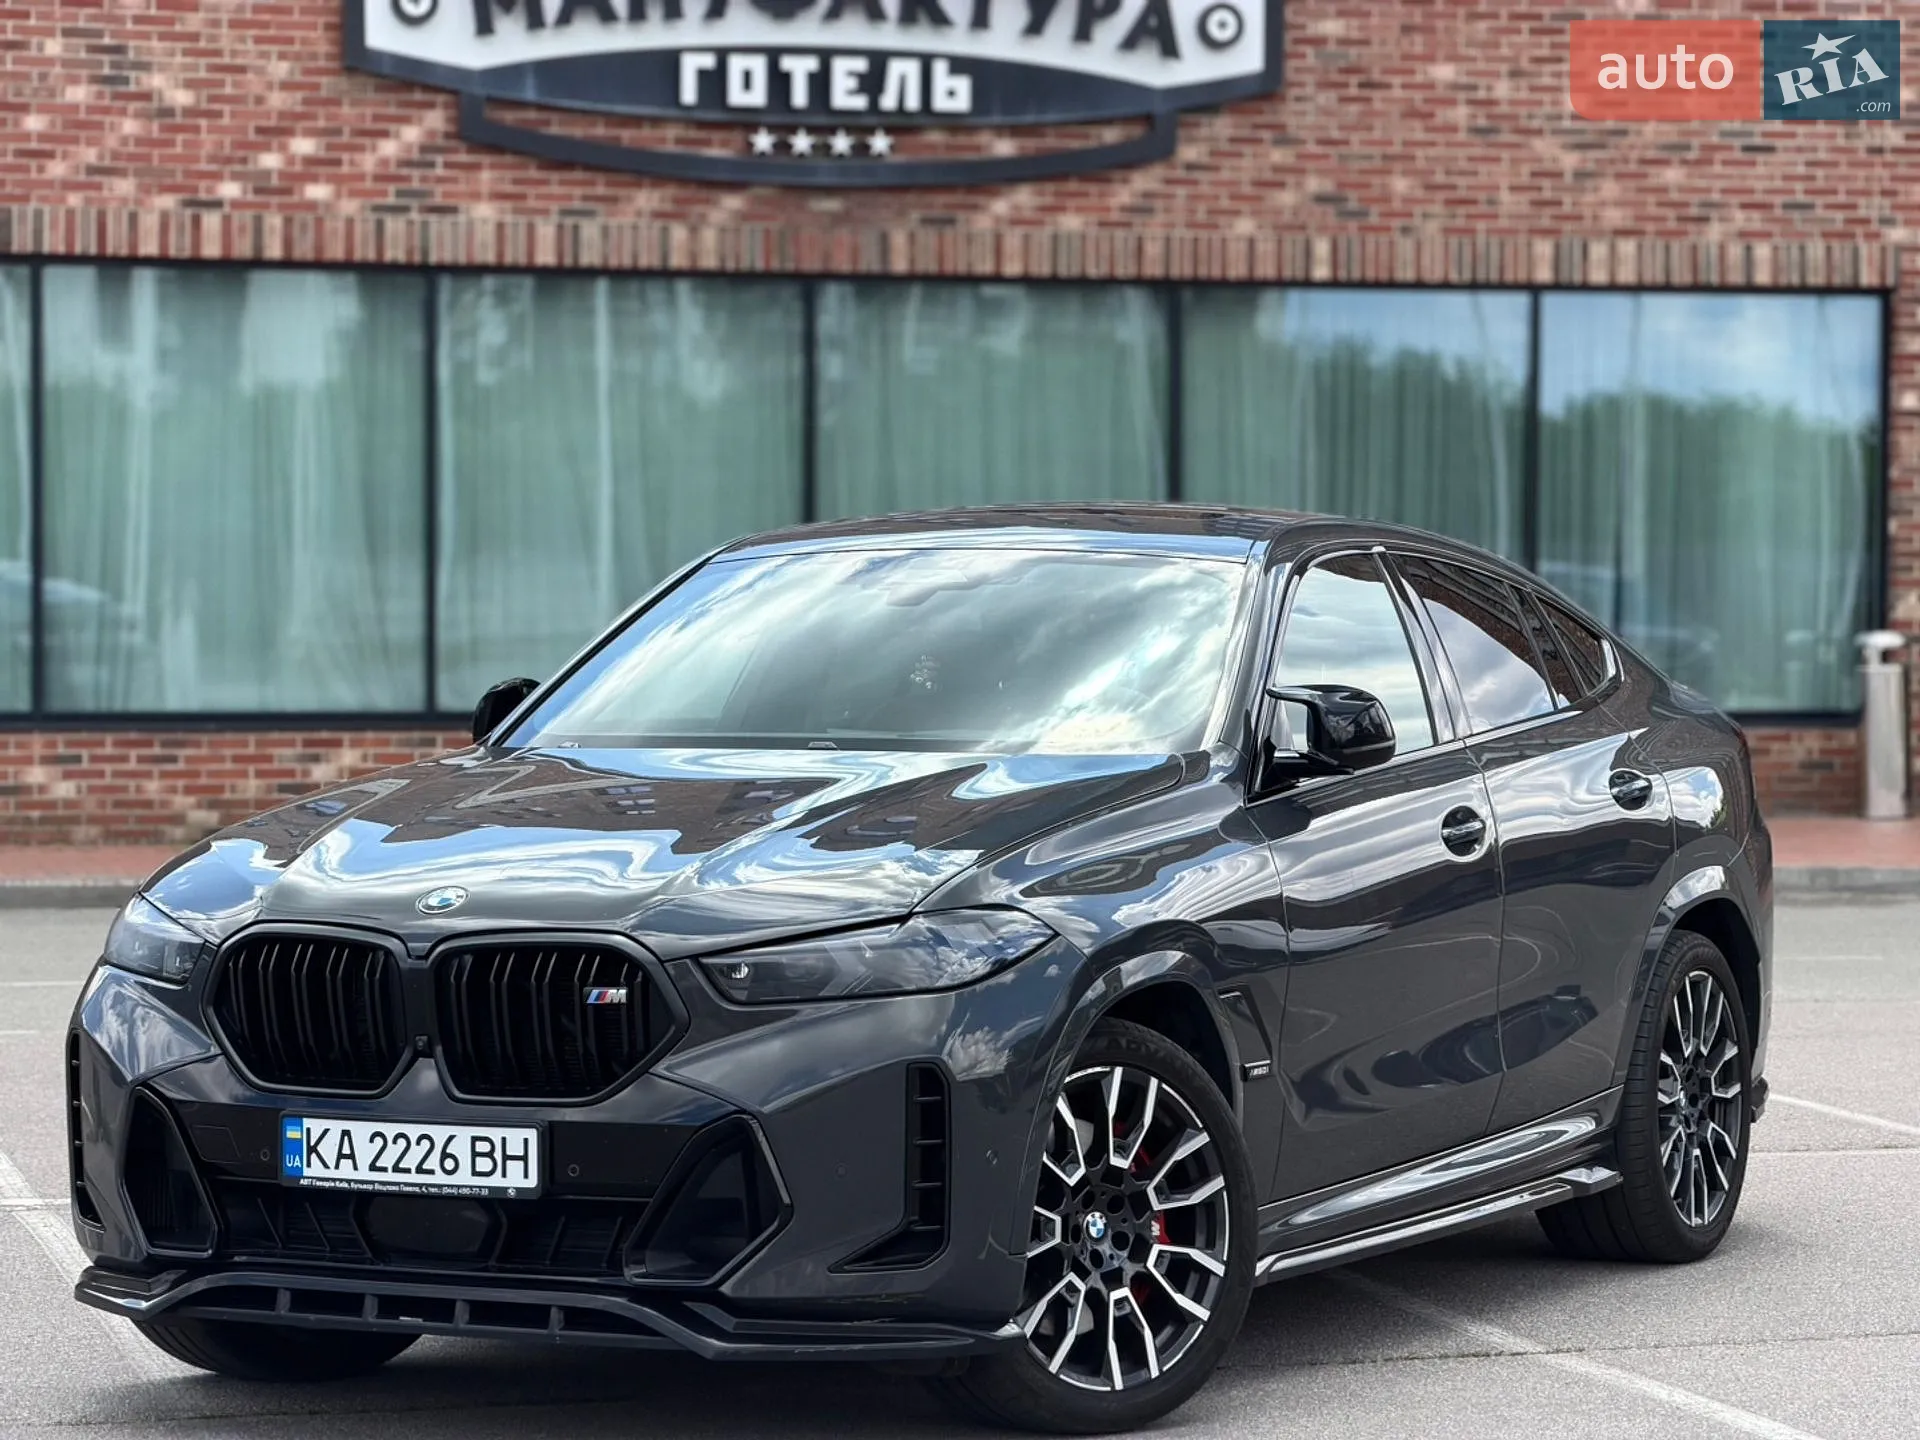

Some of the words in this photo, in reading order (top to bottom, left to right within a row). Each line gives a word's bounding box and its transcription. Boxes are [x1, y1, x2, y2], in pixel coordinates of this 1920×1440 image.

[679, 51, 973, 113] ГОТЕЛЬ
[286, 1154, 301, 1167] UA
[306, 1127, 358, 1171] KA
[368, 1131, 460, 1175] 2226
[471, 1135, 529, 1179] BH
